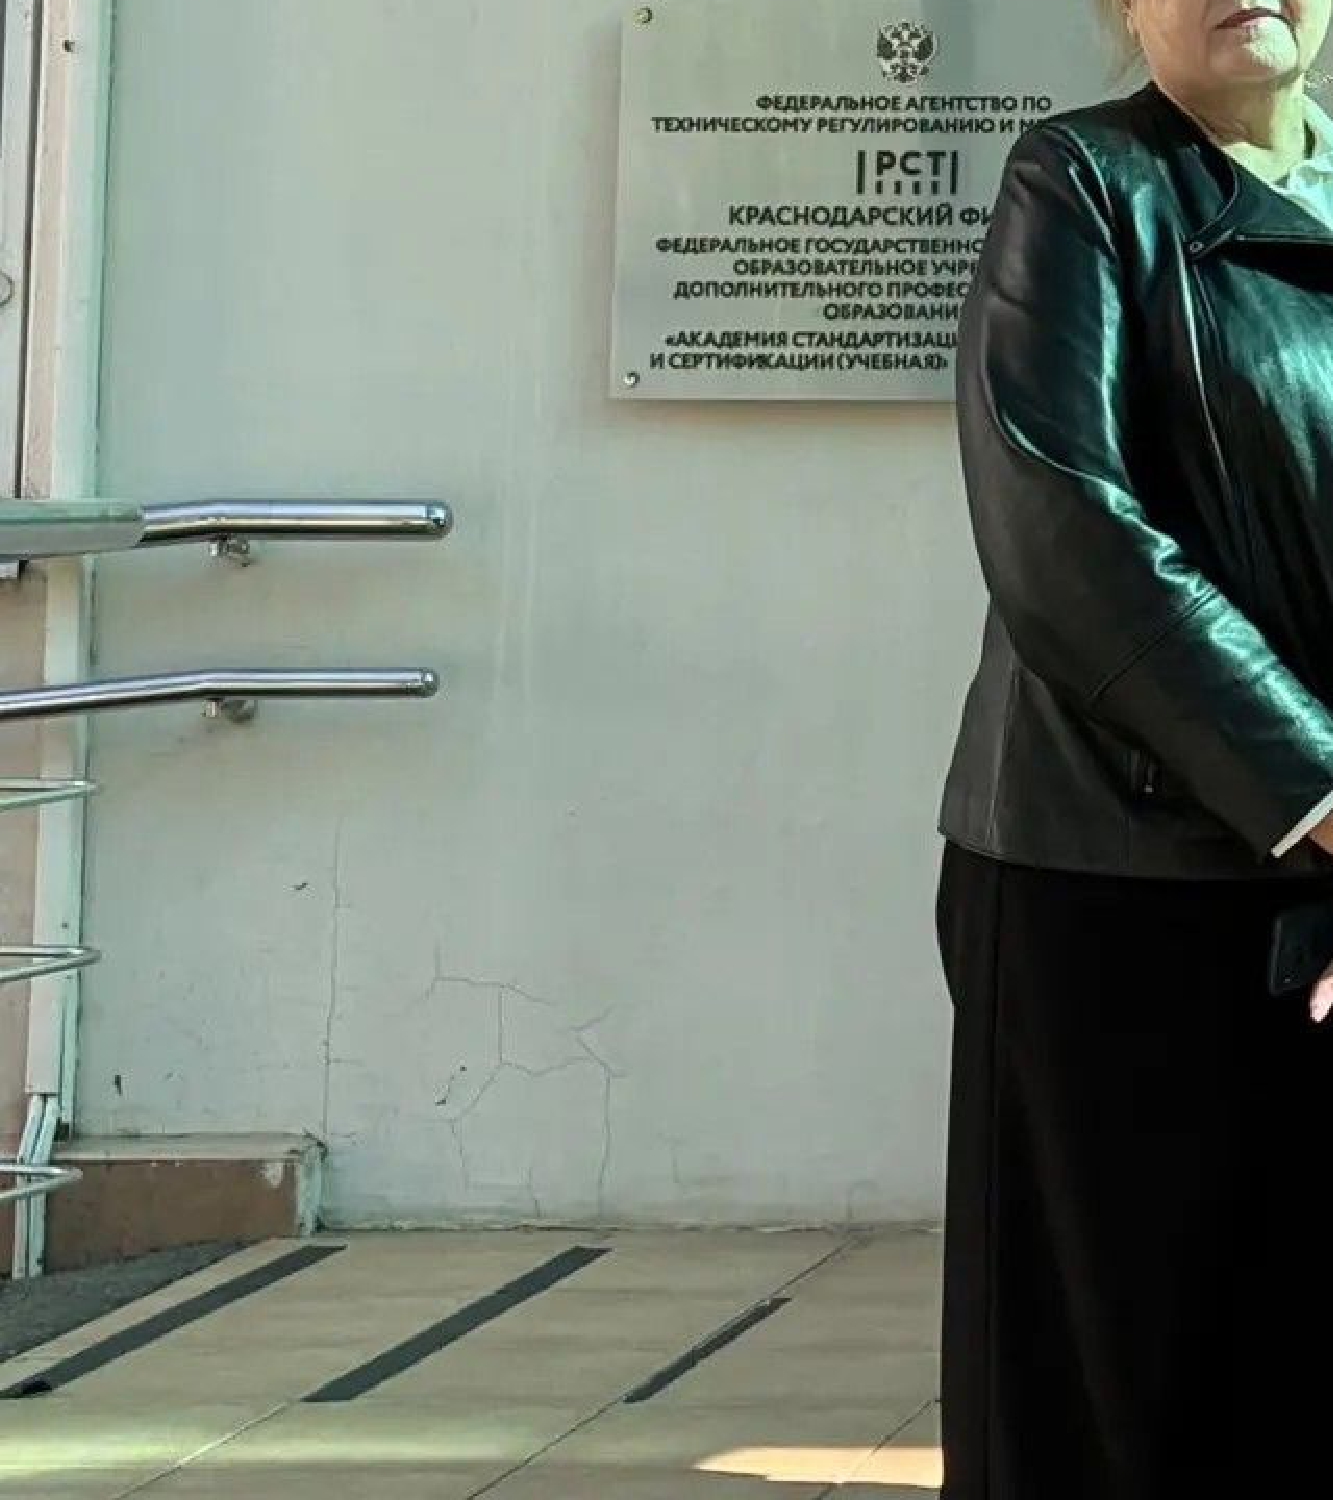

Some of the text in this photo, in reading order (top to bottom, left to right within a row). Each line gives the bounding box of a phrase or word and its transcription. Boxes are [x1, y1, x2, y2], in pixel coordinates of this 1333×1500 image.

[756, 96, 1051, 113] ФЕДЕРАЛЬНОЕ АГЕНТСТВО ПО
[652, 117, 812, 133] ТЕХНИЧЕСКОМУ
[817, 117, 996, 133] РЕГУЛИРОВАНИЮ
[1000, 119, 1015, 133] И
[729, 204, 952, 227] КРАСНОДАРСКИЙ
[656, 238, 983, 254] ФЕДЕРАЛЬНОЕ ГОСУДАРСТВЕННО
[733, 260, 927, 275] ОБРАЗОВАТЕЛЬНОЕ
[673, 281, 883, 298] ДОПОЛНИТЕЛЬНОГО
[823, 303, 959, 320] ОБРАЗОВАНИ
[665, 331, 958, 349] «АКАДЕМИЯ СТАНДАРТИЗАЦ
[650, 354, 665, 369] И
[669, 352, 833, 371] СЕРТИФИКАЦИИ
